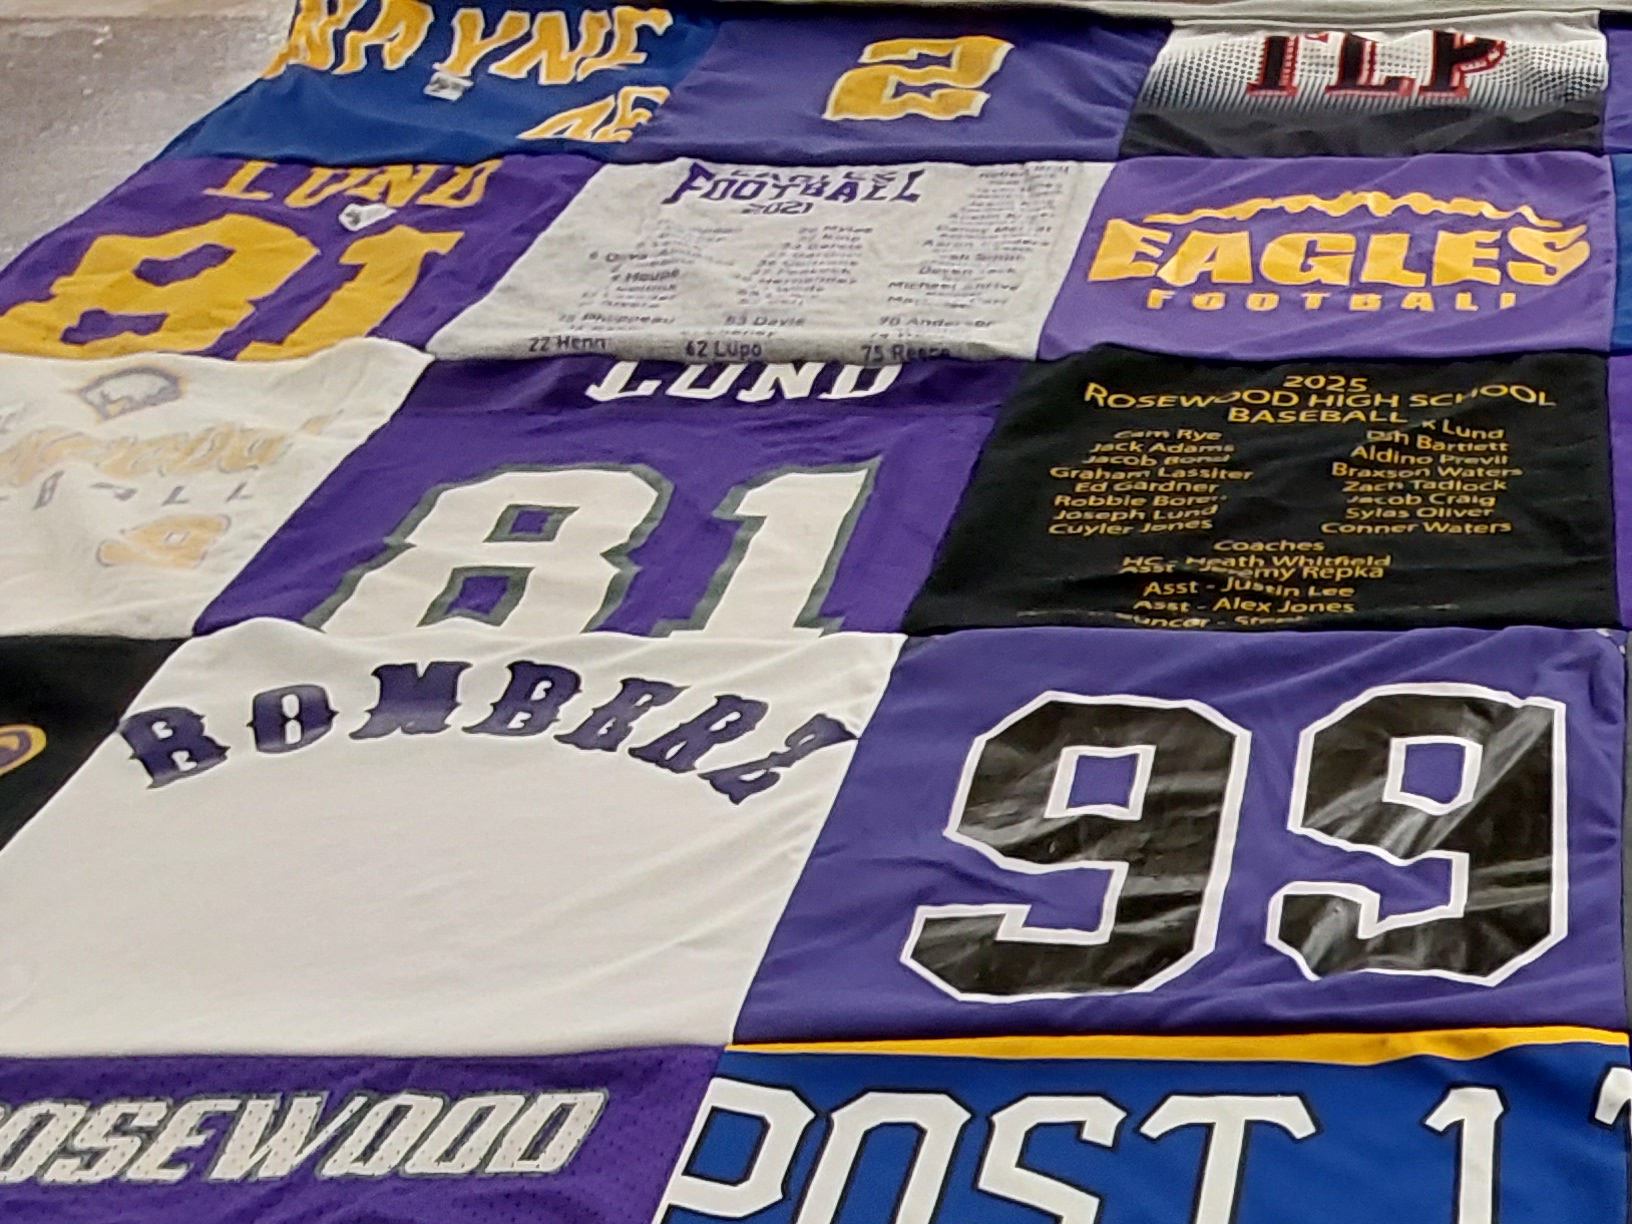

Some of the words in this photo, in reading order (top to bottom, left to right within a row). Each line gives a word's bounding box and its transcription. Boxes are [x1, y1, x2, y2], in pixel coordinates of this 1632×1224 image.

[202, 160, 503, 208] LUND
[661, 162, 925, 204] FOOTBALL
[1088, 218, 1591, 287] EAGLES
[0, 214, 466, 361] 81
[685, 340, 708, 358] 62
[714, 341, 762, 359] Lupo
[585, 361, 901, 402] LUND
[1282, 374, 1368, 392] 2025
[1308, 393, 1400, 408] HIGH
[1228, 407, 1409, 424] BASEBALL
[1176, 428, 1223, 442] Rye
[1441, 418, 1505, 440] Lund
[1089, 441, 1145, 454] Jack
[1149, 442, 1236, 454] Adams
[1415, 433, 1510, 453] Bartlett
[1081, 454, 1158, 467] Jacob
[1350, 444, 1434, 466] Aldino
[1049, 466, 1151, 480] Graham
[1157, 466, 1254, 481] Lassiter
[1331, 461, 1431, 480] Braxson
[1437, 465, 1524, 478] Waters
[1074, 481, 1109, 493] Ed
[1113, 480, 1220, 494] Gardner
[1341, 480, 1405, 494] Zach
[1410, 478, 1509, 492] Tadlock
[1053, 494, 1147, 508] Robbie
[1346, 493, 1423, 506] Jacob
[1428, 492, 1497, 508] Craig
[1053, 509, 1146, 523] Joseph
[1152, 504, 1219, 520] Lund
[1345, 506, 1411, 521] Sylas
[1415, 506, 1496, 519] Oliver
[1048, 522, 1135, 537] Cuyler
[1138, 519, 1213, 534] Jones
[1320, 520, 1420, 535] Conner
[1421, 519, 1514, 535] Waters
[302, 456, 882, 639] 81
[1212, 538, 1326, 552] Coaches
[1121, 555, 1165, 567] HC
[1185, 554, 1266, 569] Heath
[1270, 554, 1393, 568] Whitfield
[1301, 565, 1385, 582] Repka
[1142, 580, 1199, 597] Asst
[1220, 575, 1300, 598] Justin
[1307, 584, 1356, 598] Lee
[1132, 600, 1190, 613] Asst
[1211, 596, 1273, 614] Alex
[1276, 599, 1356, 614] Jones
[898, 682, 1568, 1003] 99
[0, 1087, 608, 1187] OSEWOOD
